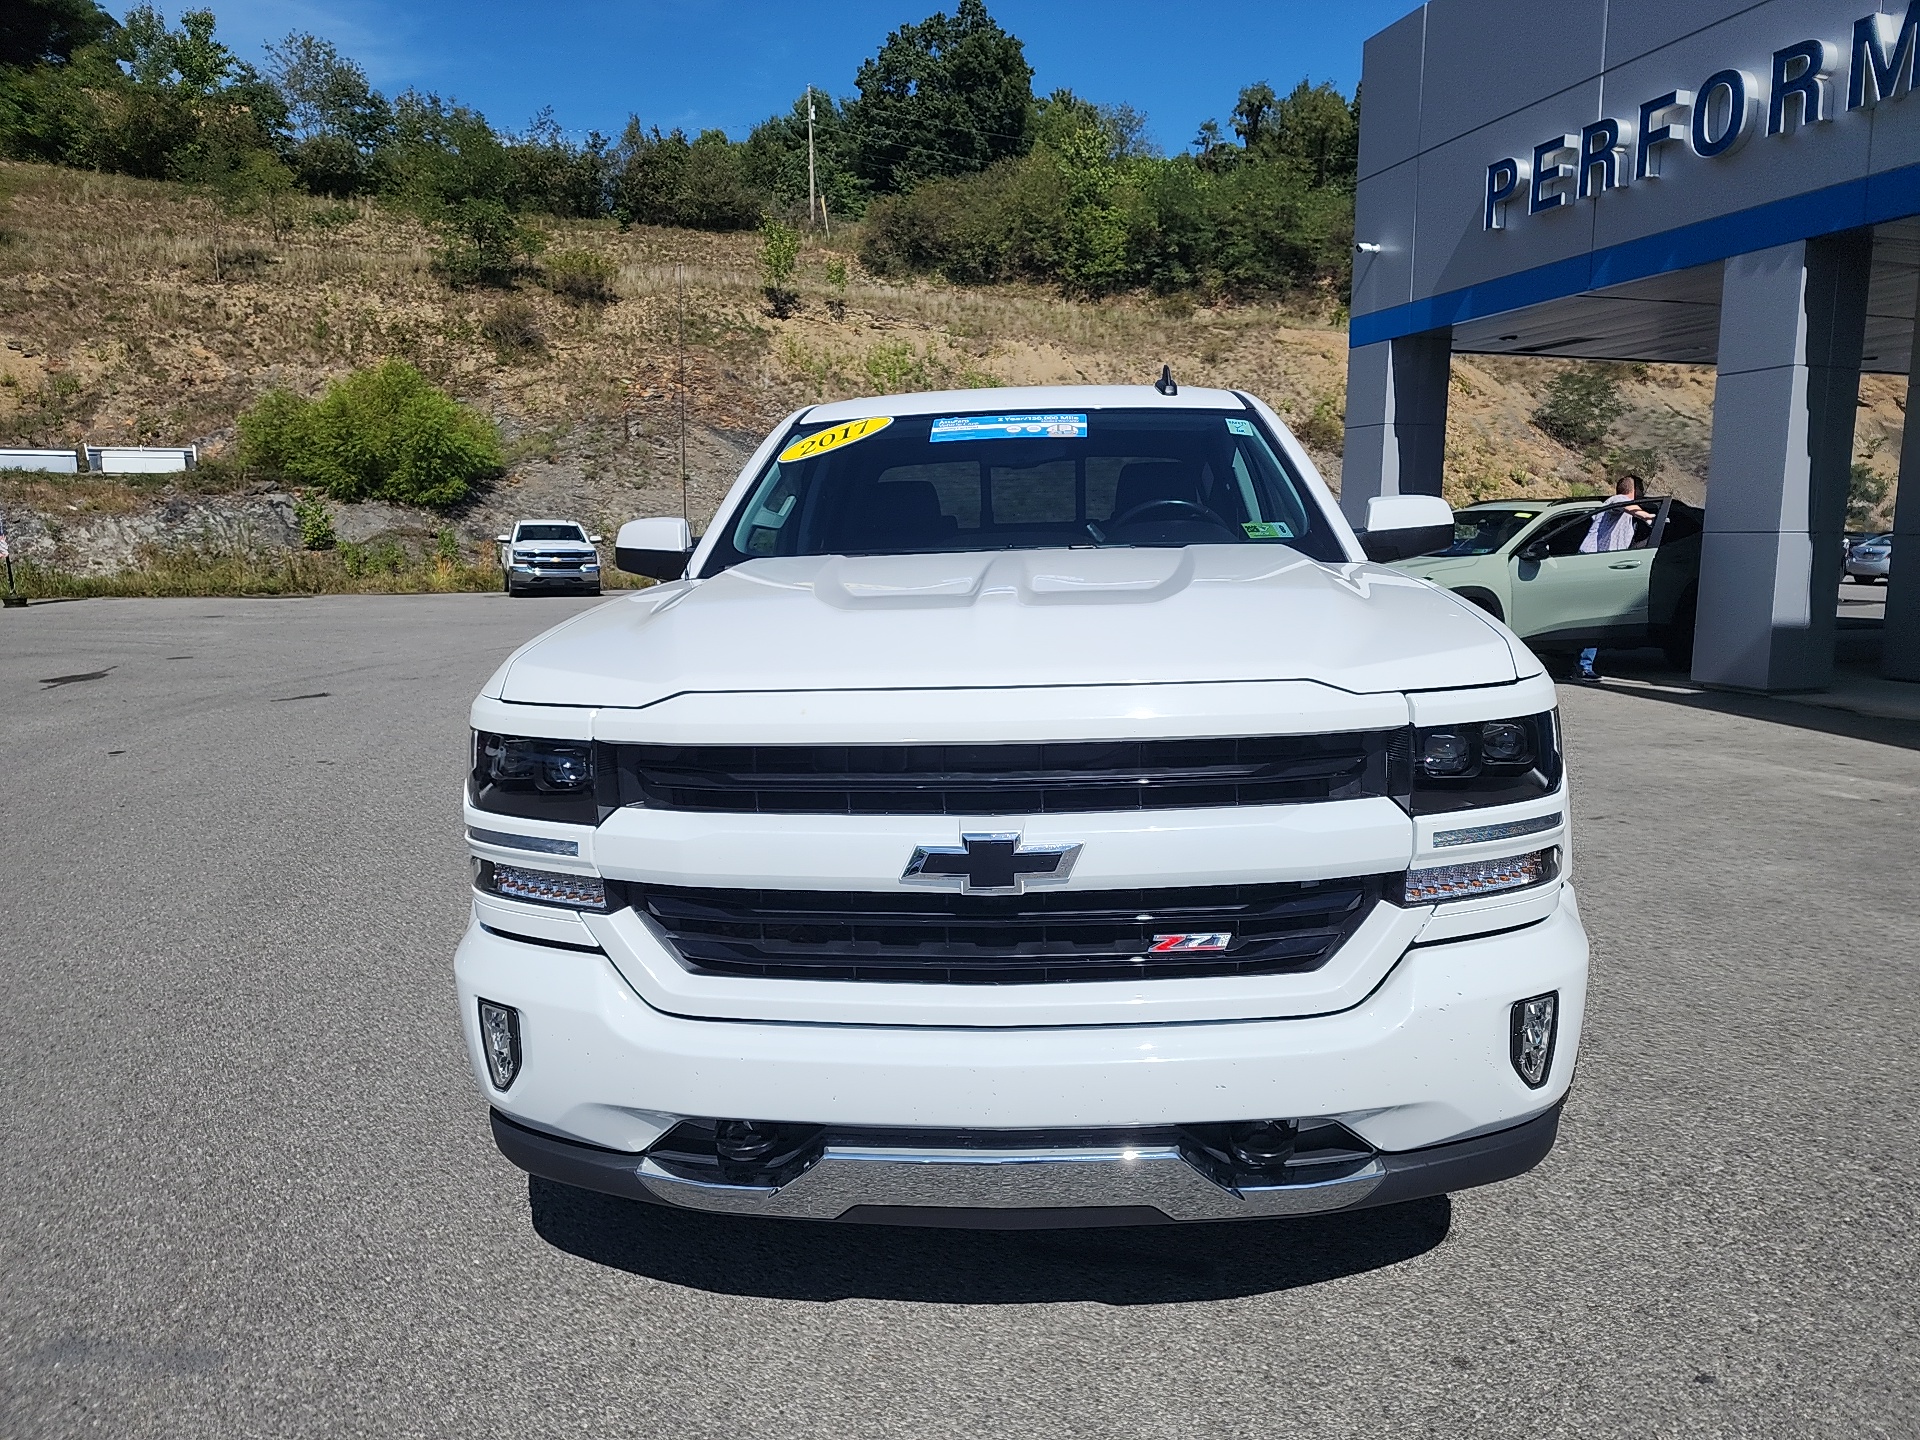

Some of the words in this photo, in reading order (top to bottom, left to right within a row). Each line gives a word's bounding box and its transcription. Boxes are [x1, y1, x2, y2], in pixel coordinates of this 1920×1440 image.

[1483, 0, 1920, 231] PERFORM
[800, 420, 869, 456] 2017
[1148, 932, 1231, 952] Z71
